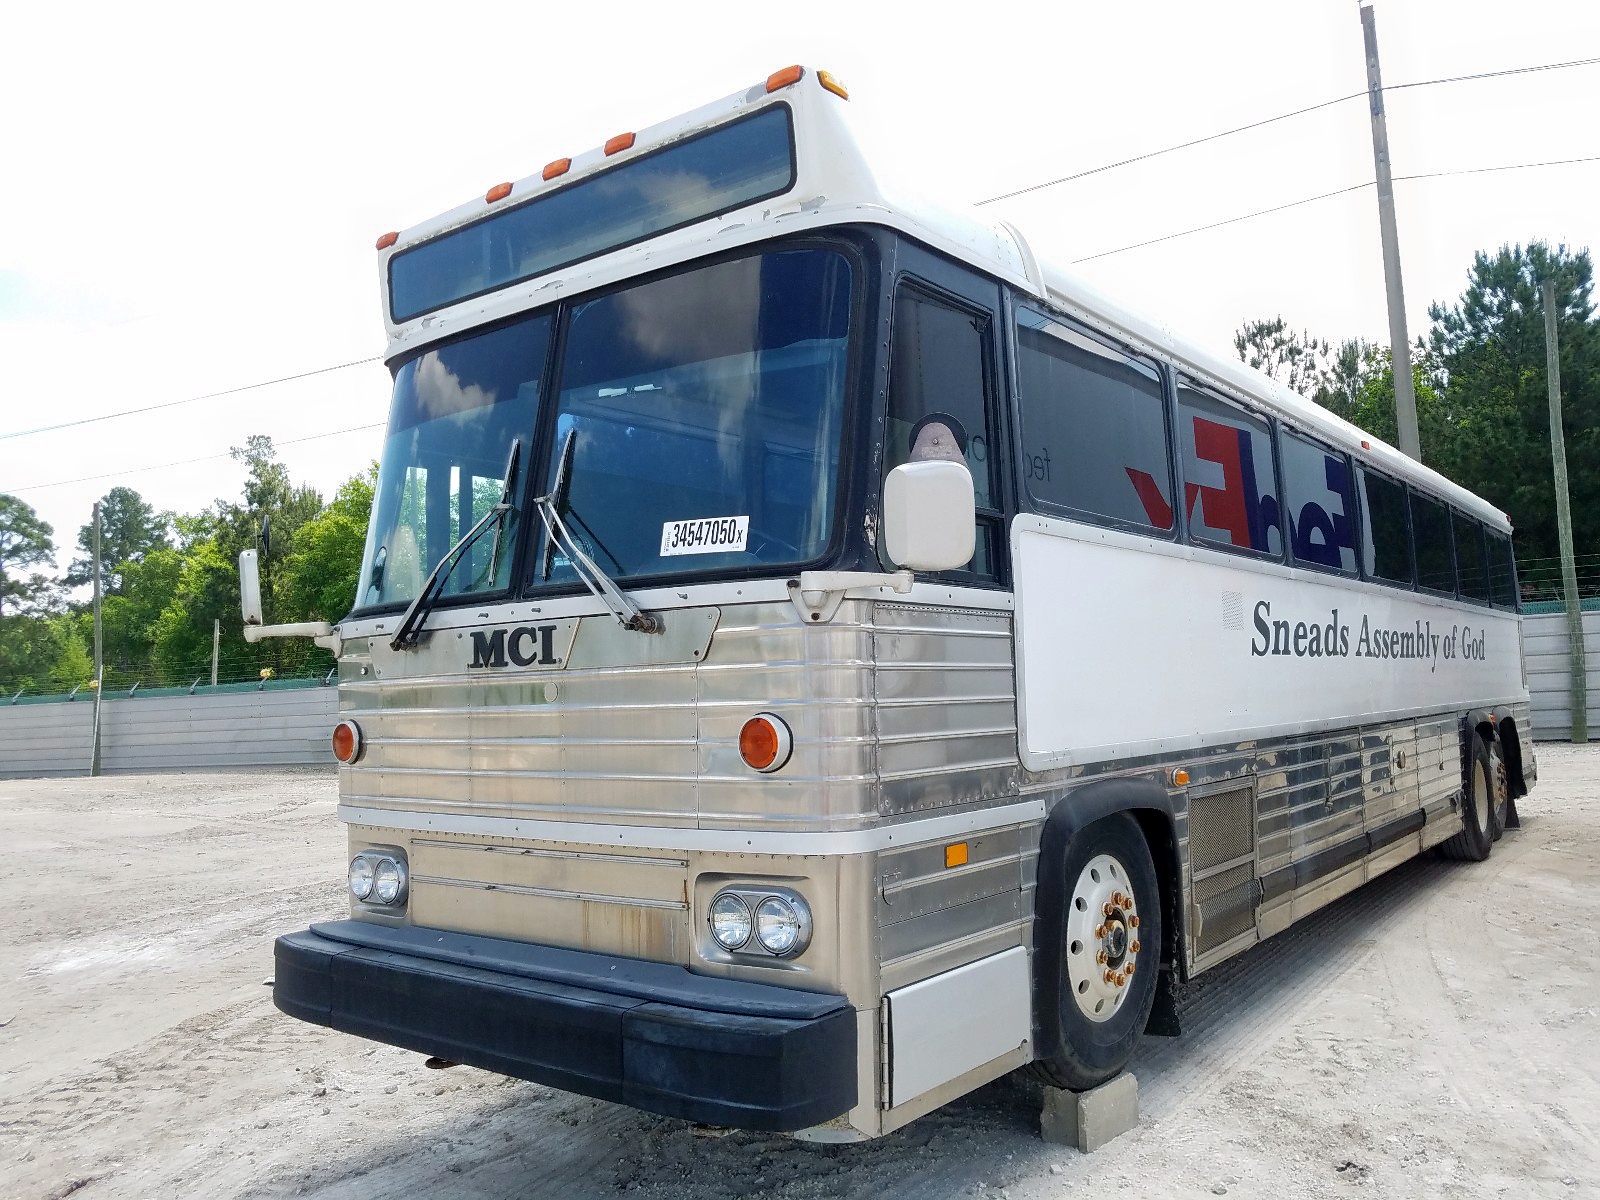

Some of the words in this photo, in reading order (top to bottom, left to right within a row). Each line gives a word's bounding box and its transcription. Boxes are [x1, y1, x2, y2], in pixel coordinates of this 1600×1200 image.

[470, 625, 557, 668] MCI
[1251, 600, 1350, 657] Sneads
[1355, 614, 1440, 673] Assembly
[1443, 624, 1458, 660] of
[1461, 626, 1486, 661] God
